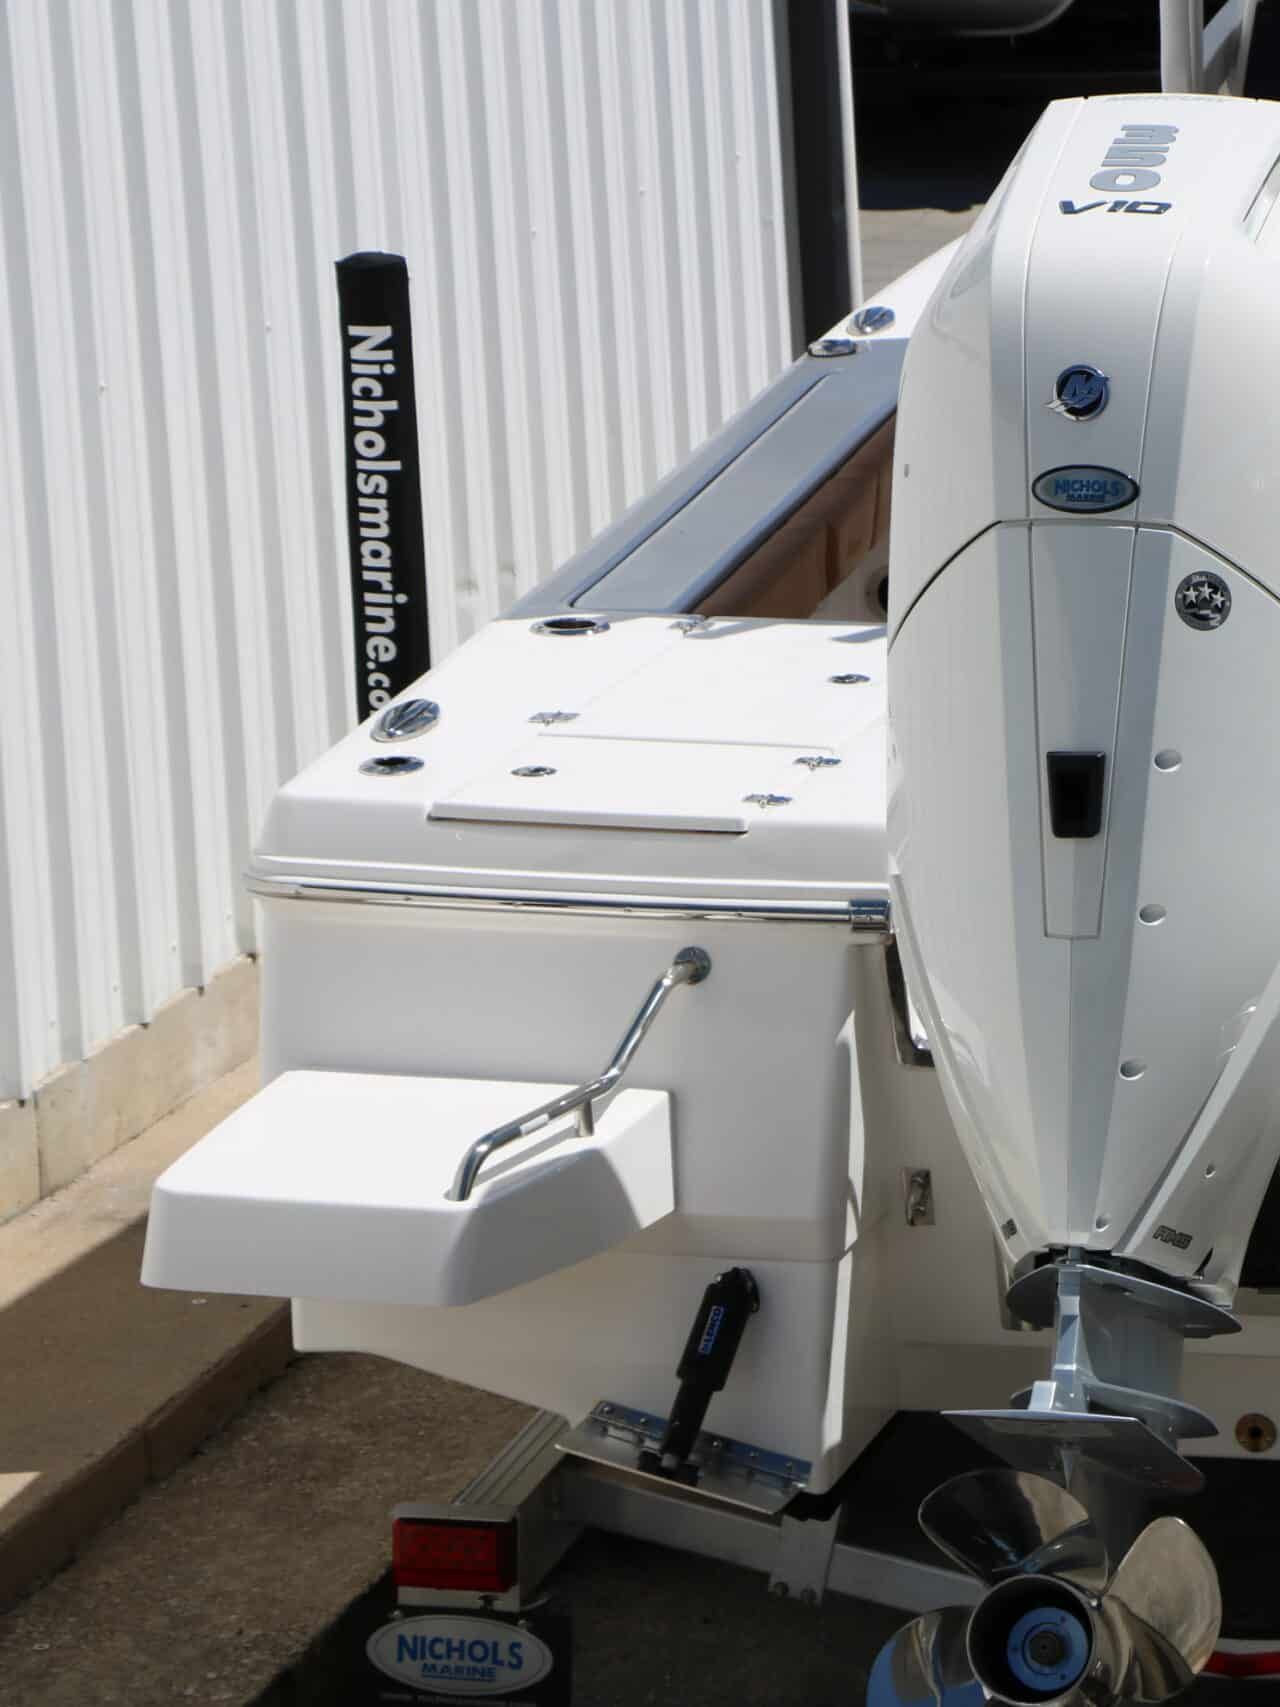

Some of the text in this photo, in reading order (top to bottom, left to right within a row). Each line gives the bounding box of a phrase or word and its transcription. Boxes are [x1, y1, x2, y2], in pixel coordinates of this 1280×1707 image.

[1059, 199, 1172, 215] V10
[348, 325, 408, 716] Nicholsmarine.co
[395, 1634, 524, 1671] NICHOLS
[420, 1663, 497, 1679] MARINE
